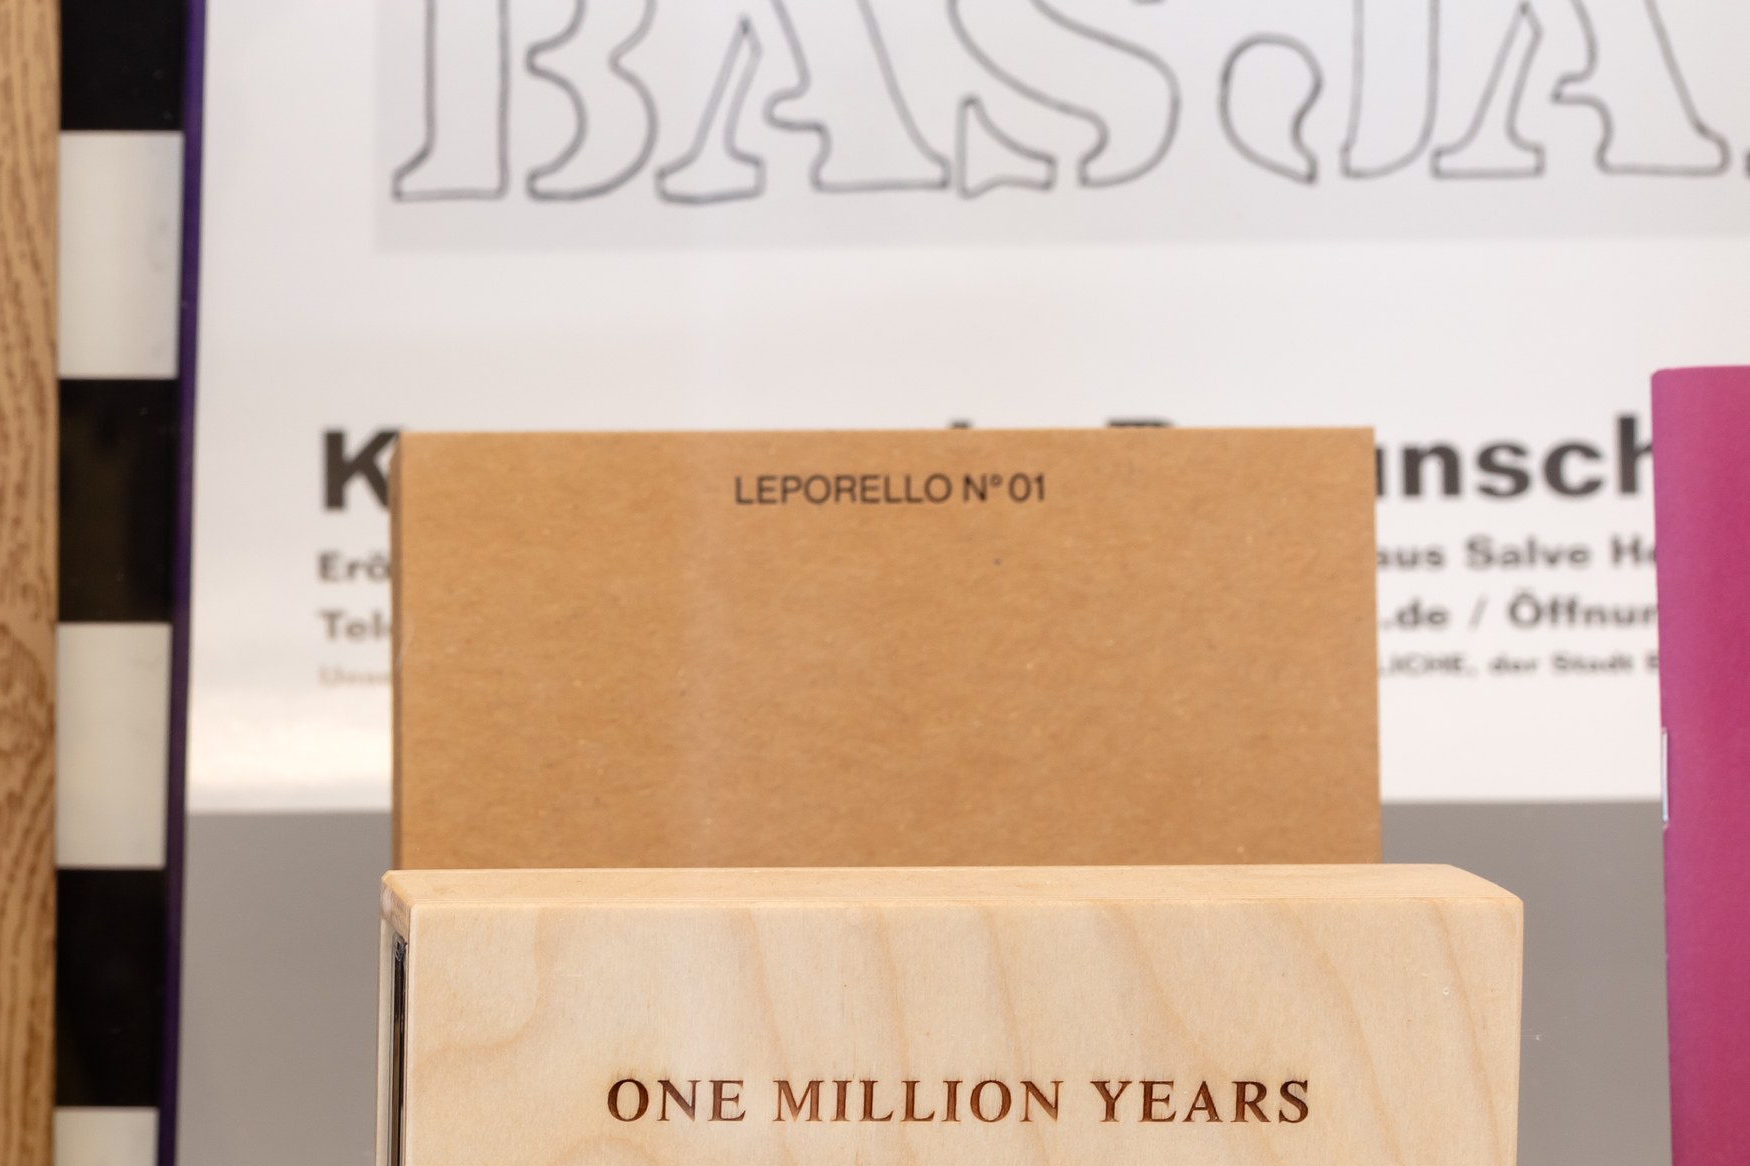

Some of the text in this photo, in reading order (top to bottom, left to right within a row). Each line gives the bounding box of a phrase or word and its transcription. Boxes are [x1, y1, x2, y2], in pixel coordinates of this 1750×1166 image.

[734, 472, 954, 506] LEPORELLO
[1464, 534, 1590, 570] Salve
[606, 1076, 1311, 1124] ONE MILLION YEARS
